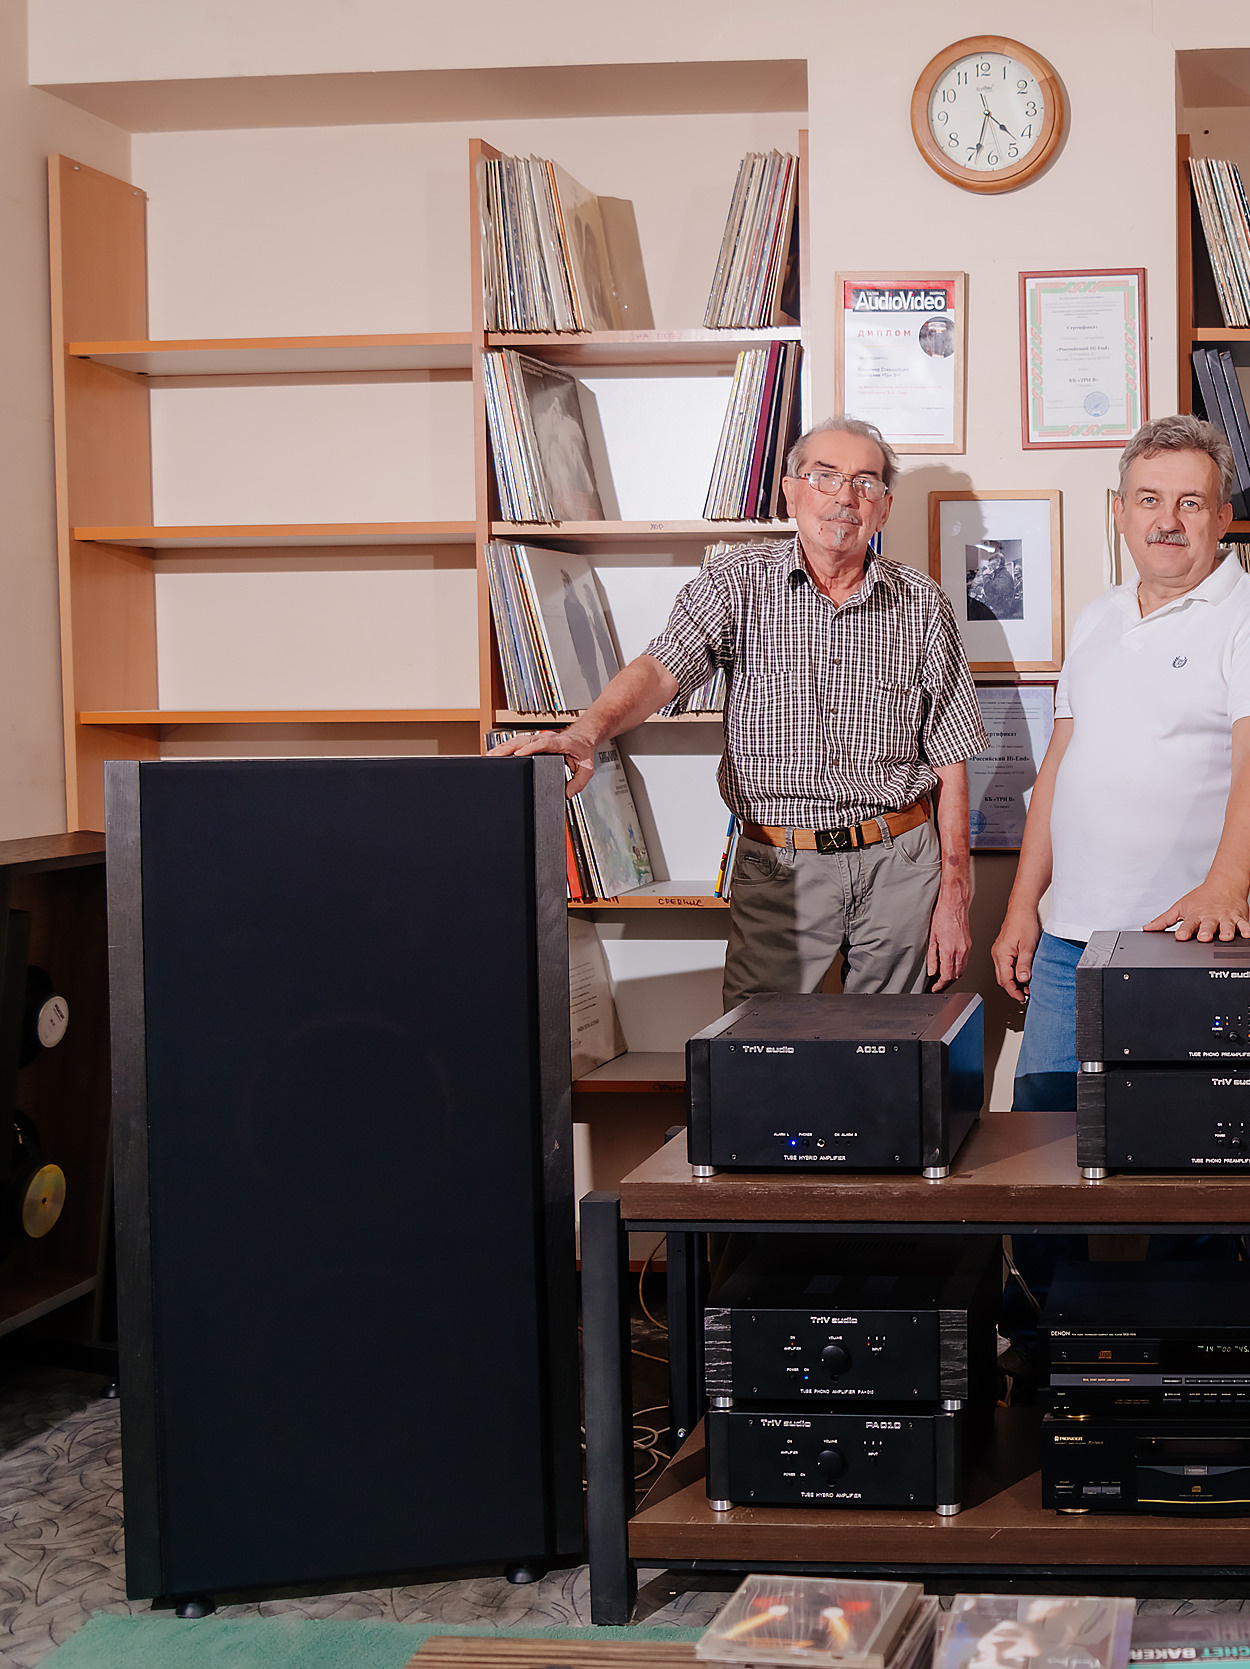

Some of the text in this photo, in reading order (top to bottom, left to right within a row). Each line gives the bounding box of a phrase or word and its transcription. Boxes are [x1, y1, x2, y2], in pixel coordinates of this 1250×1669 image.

[976, 62, 991, 77] 12
[1003, 66, 1007, 80] 1
[957, 72, 968, 85] 11
[1016, 80, 1028, 94] 2
[942, 89, 957, 103] 10
[1025, 101, 1038, 117] 3
[937, 111, 949, 127] 9
[1020, 124, 1032, 139] 4
[948, 132, 960, 148] 8
[966, 146, 978, 162] 7
[987, 150, 999, 165] 6
[1008, 143, 1019, 158] 5
[855, 291, 946, 310] AudioVideo
[857, 329, 911, 338] ДИПЛОМ
[1208, 970, 1230, 979] TriV
[742, 1045, 795, 1054] TriV audio
[855, 1045, 886, 1054] A010
[1211, 1078, 1232, 1086] TriV
[809, 1316, 858, 1324] TriV audio
[760, 1418, 812, 1428] TriV audio
[865, 1421, 902, 1430] PA010
[1129, 1646, 1250, 1660] CHET BAKER
